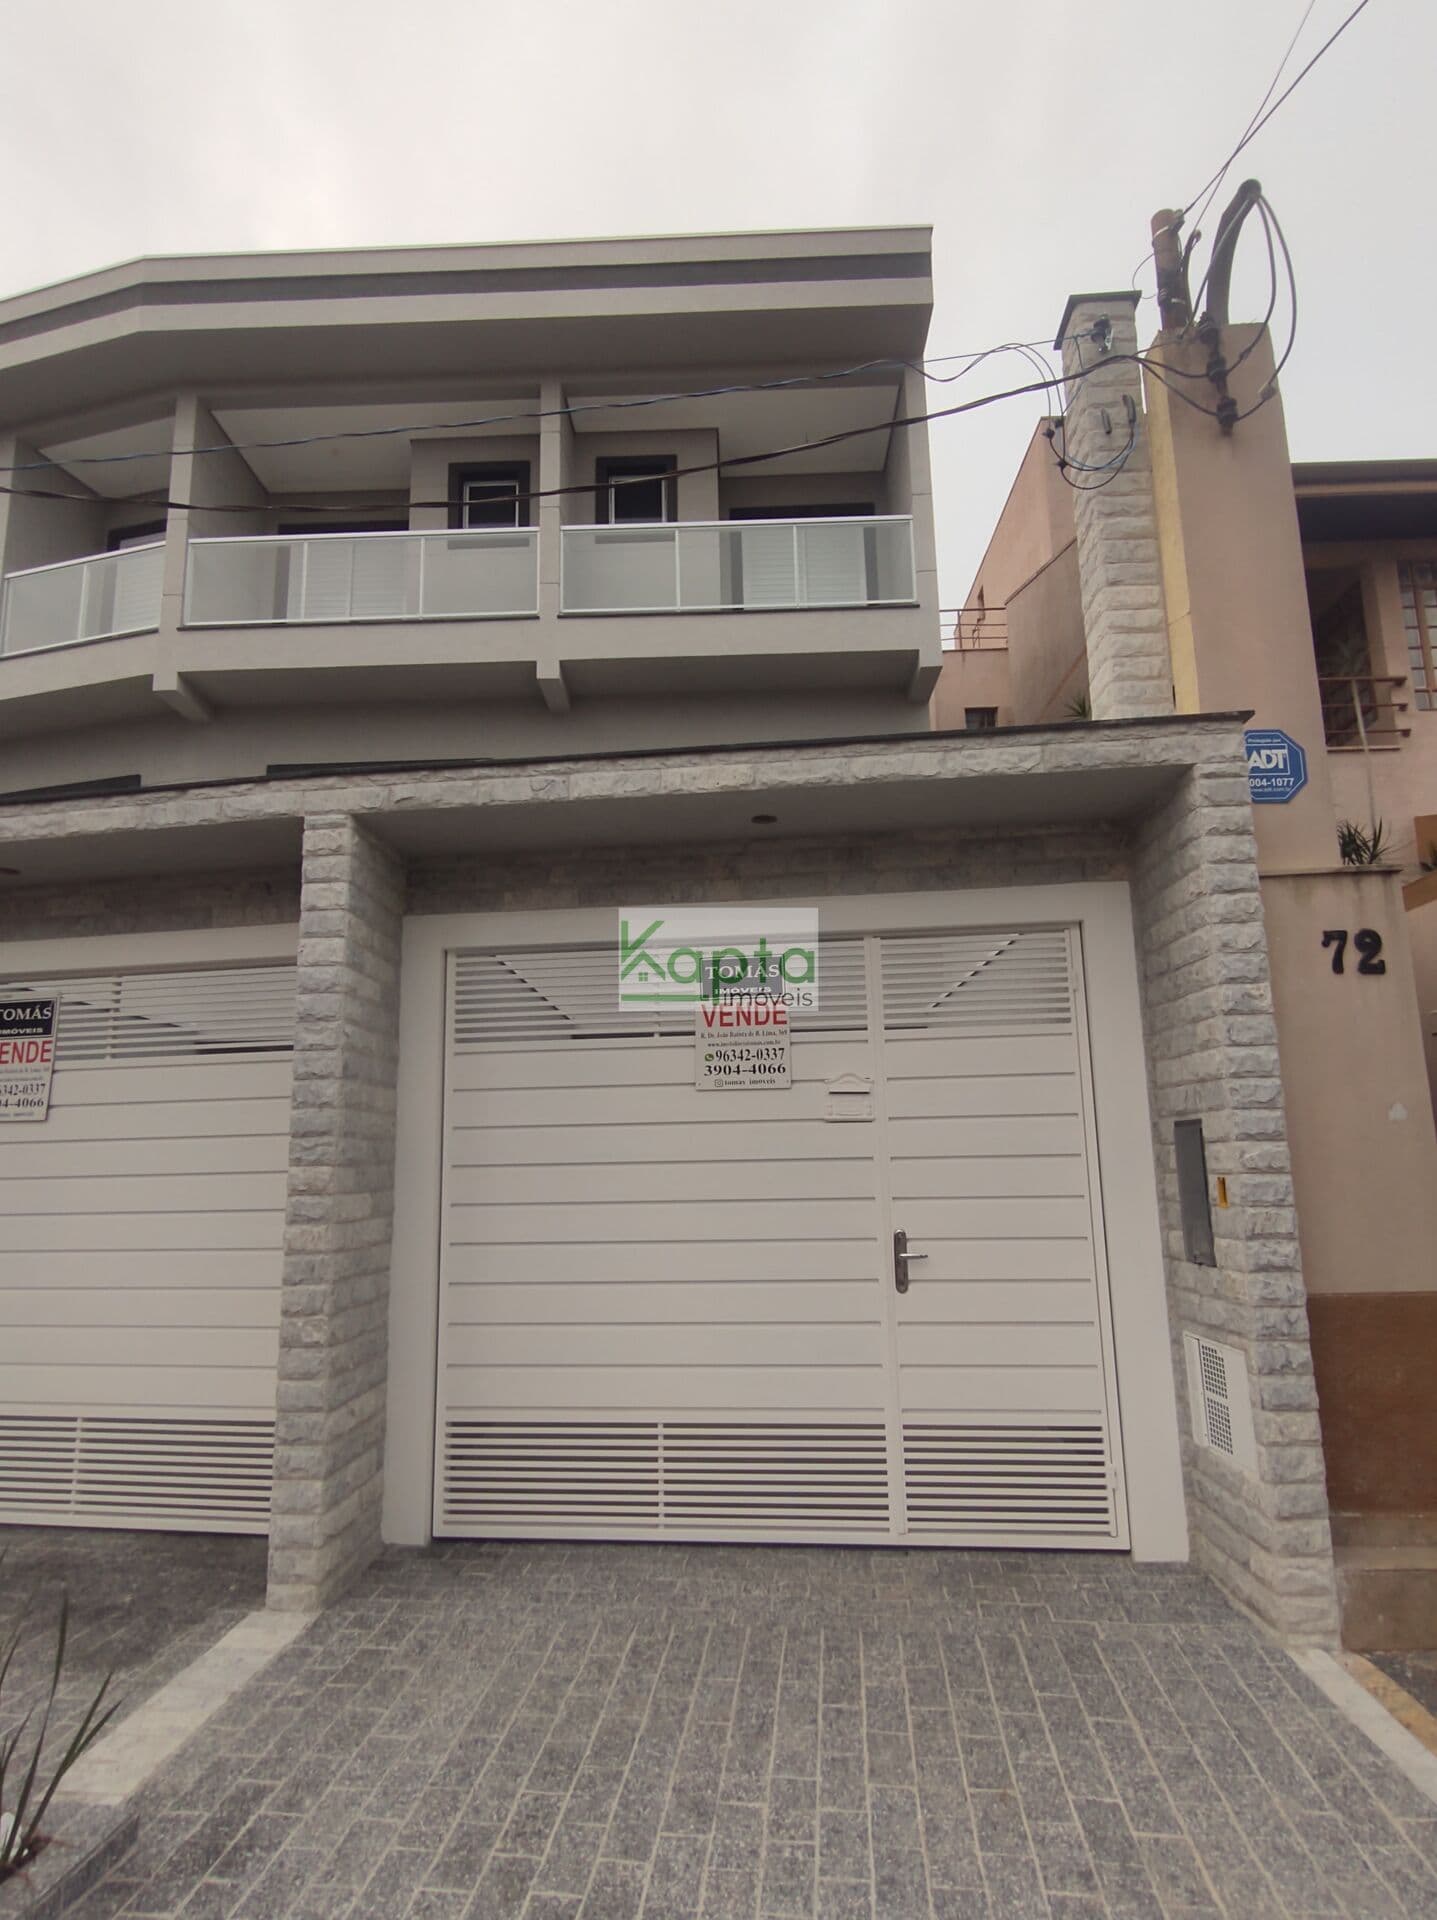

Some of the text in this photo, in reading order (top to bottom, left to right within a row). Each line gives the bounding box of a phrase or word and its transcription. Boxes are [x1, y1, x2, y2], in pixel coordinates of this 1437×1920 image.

[1248, 749, 1286, 769] ADT
[1321, 929, 1386, 975] 72
[705, 963, 780, 979] TOMÁS
[701, 1003, 787, 1028] VENDE
[715, 1047, 785, 1062] 96342-0337
[704, 1063, 786, 1076] 3904-4066
